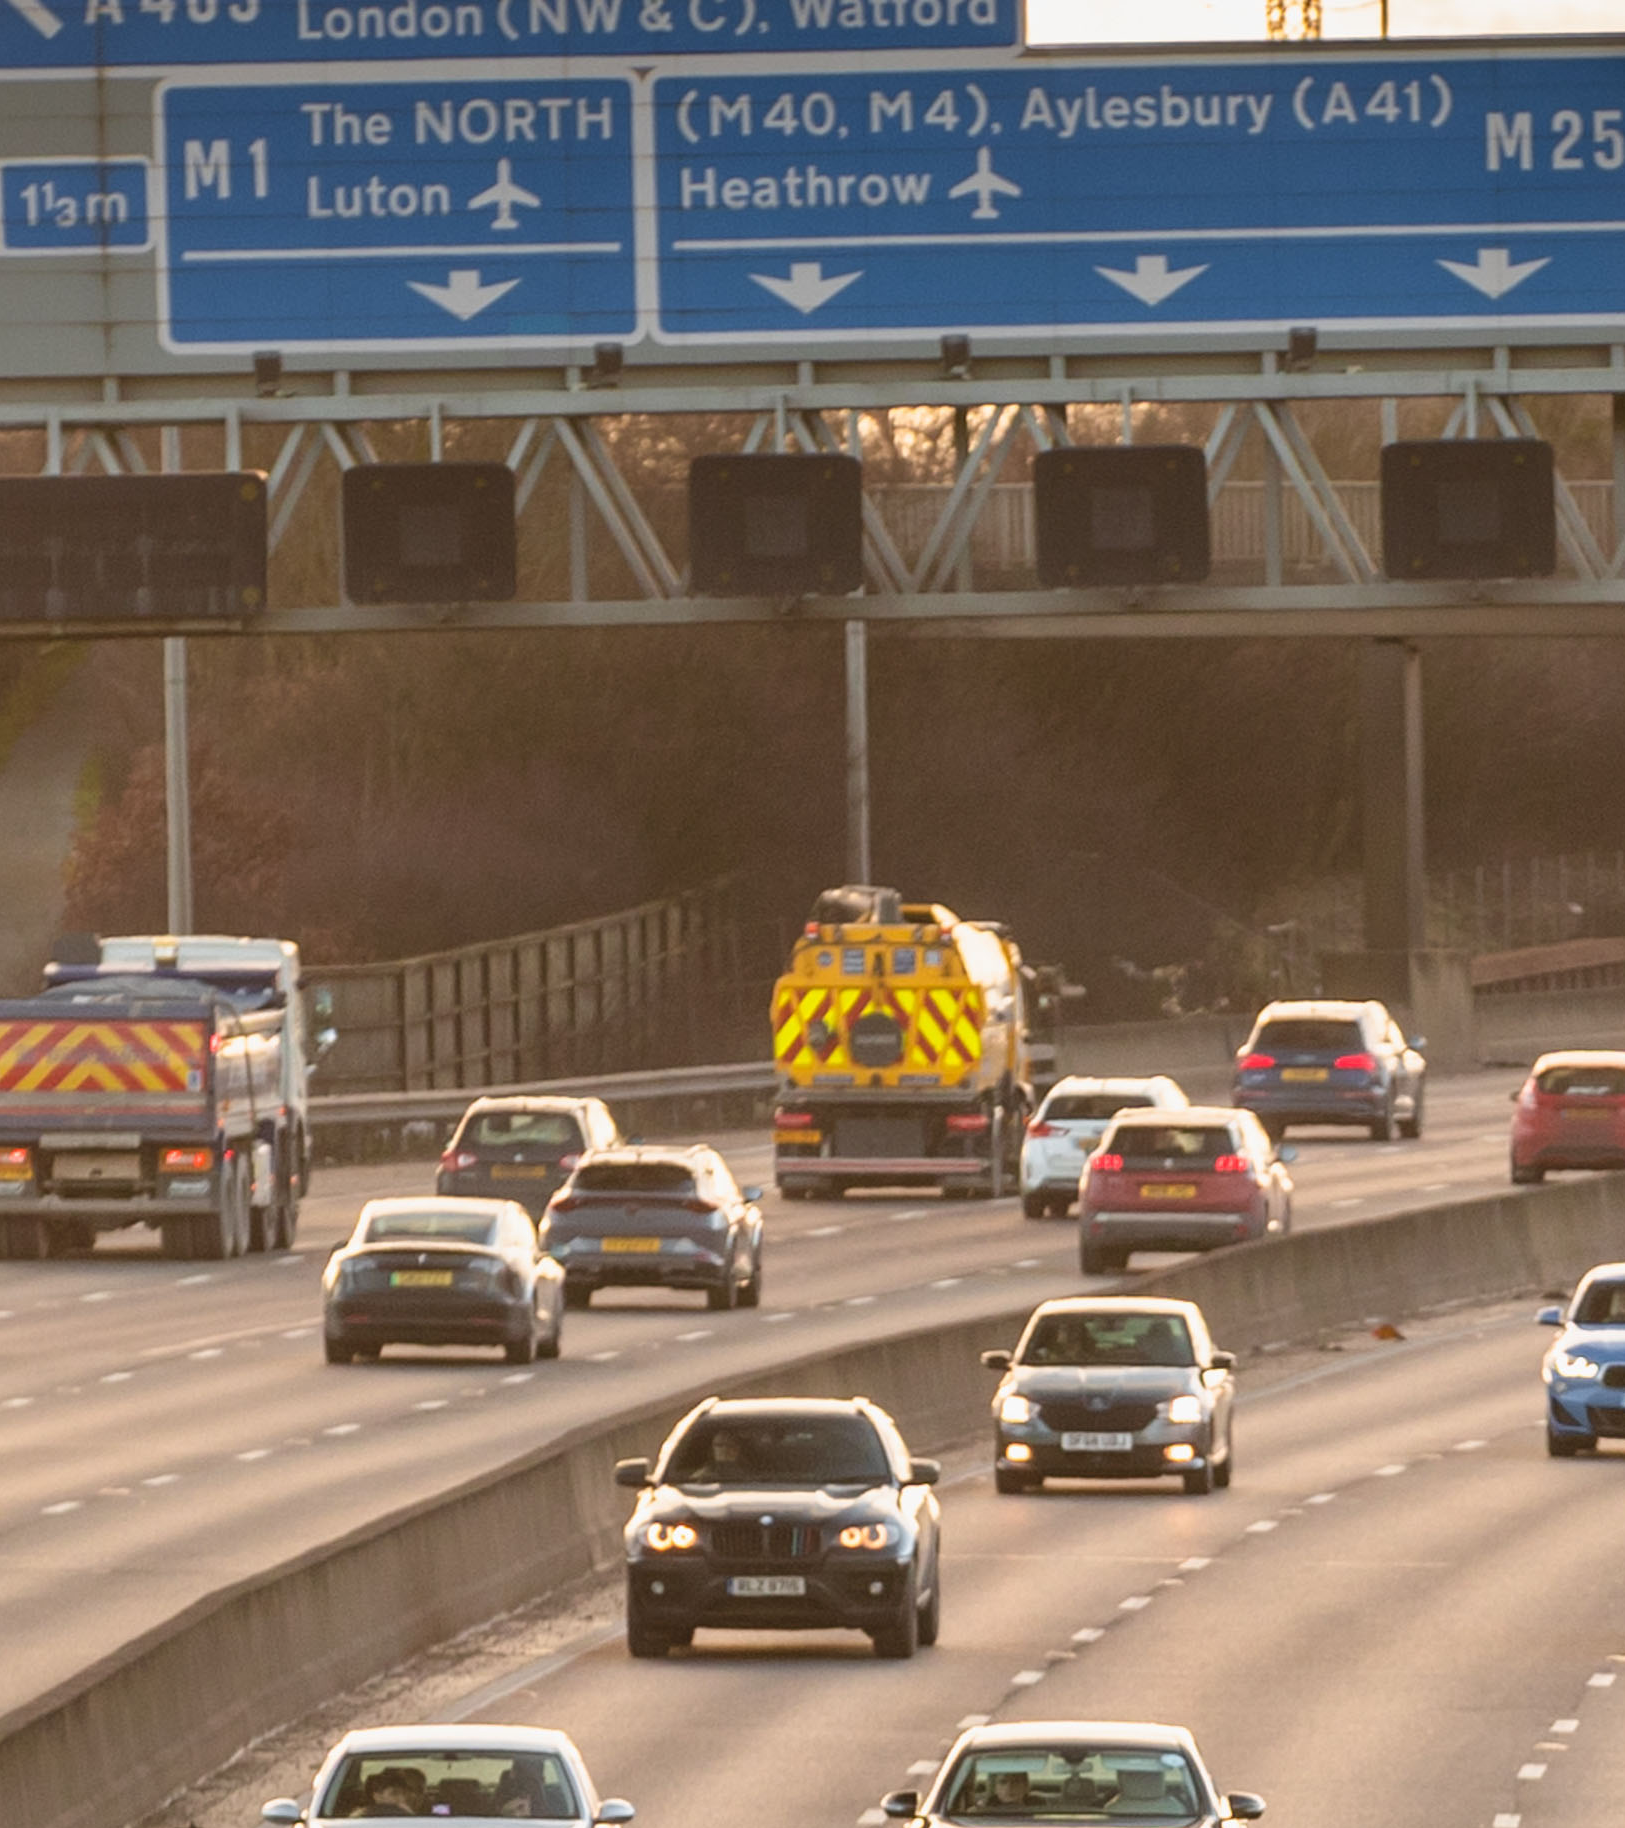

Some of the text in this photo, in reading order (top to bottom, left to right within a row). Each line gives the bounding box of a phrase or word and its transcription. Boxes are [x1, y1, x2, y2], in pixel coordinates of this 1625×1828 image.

[298, 0, 482, 40] London
[639, 0, 674, 32] &
[790, 0, 997, 28] Watford
[301, 98, 613, 146] The NORTH
[1019, 86, 1274, 138] Aylesbury
[307, 176, 451, 218] Luton
[680, 165, 932, 210] Heathrow
